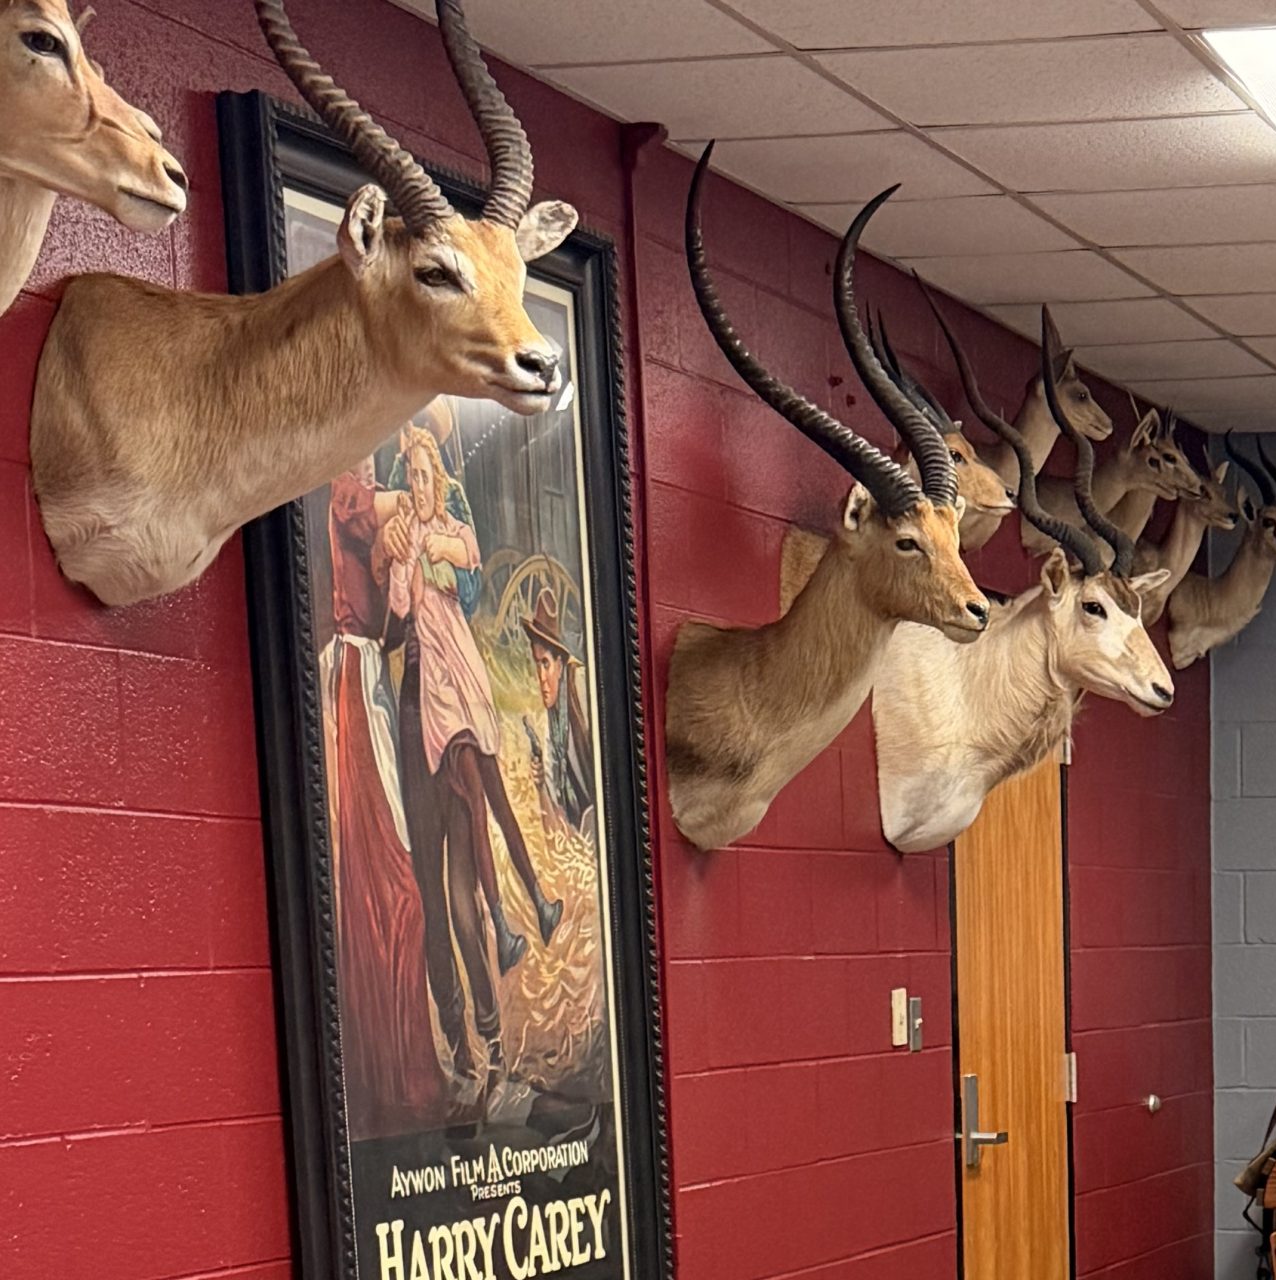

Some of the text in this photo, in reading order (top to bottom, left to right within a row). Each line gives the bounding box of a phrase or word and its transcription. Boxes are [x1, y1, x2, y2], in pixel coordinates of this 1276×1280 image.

[391, 1165, 446, 1198] AYWON
[451, 1155, 485, 1187] FILM
[502, 1140, 589, 1178] CORPORATION
[471, 1180, 522, 1201] PRESENTS
